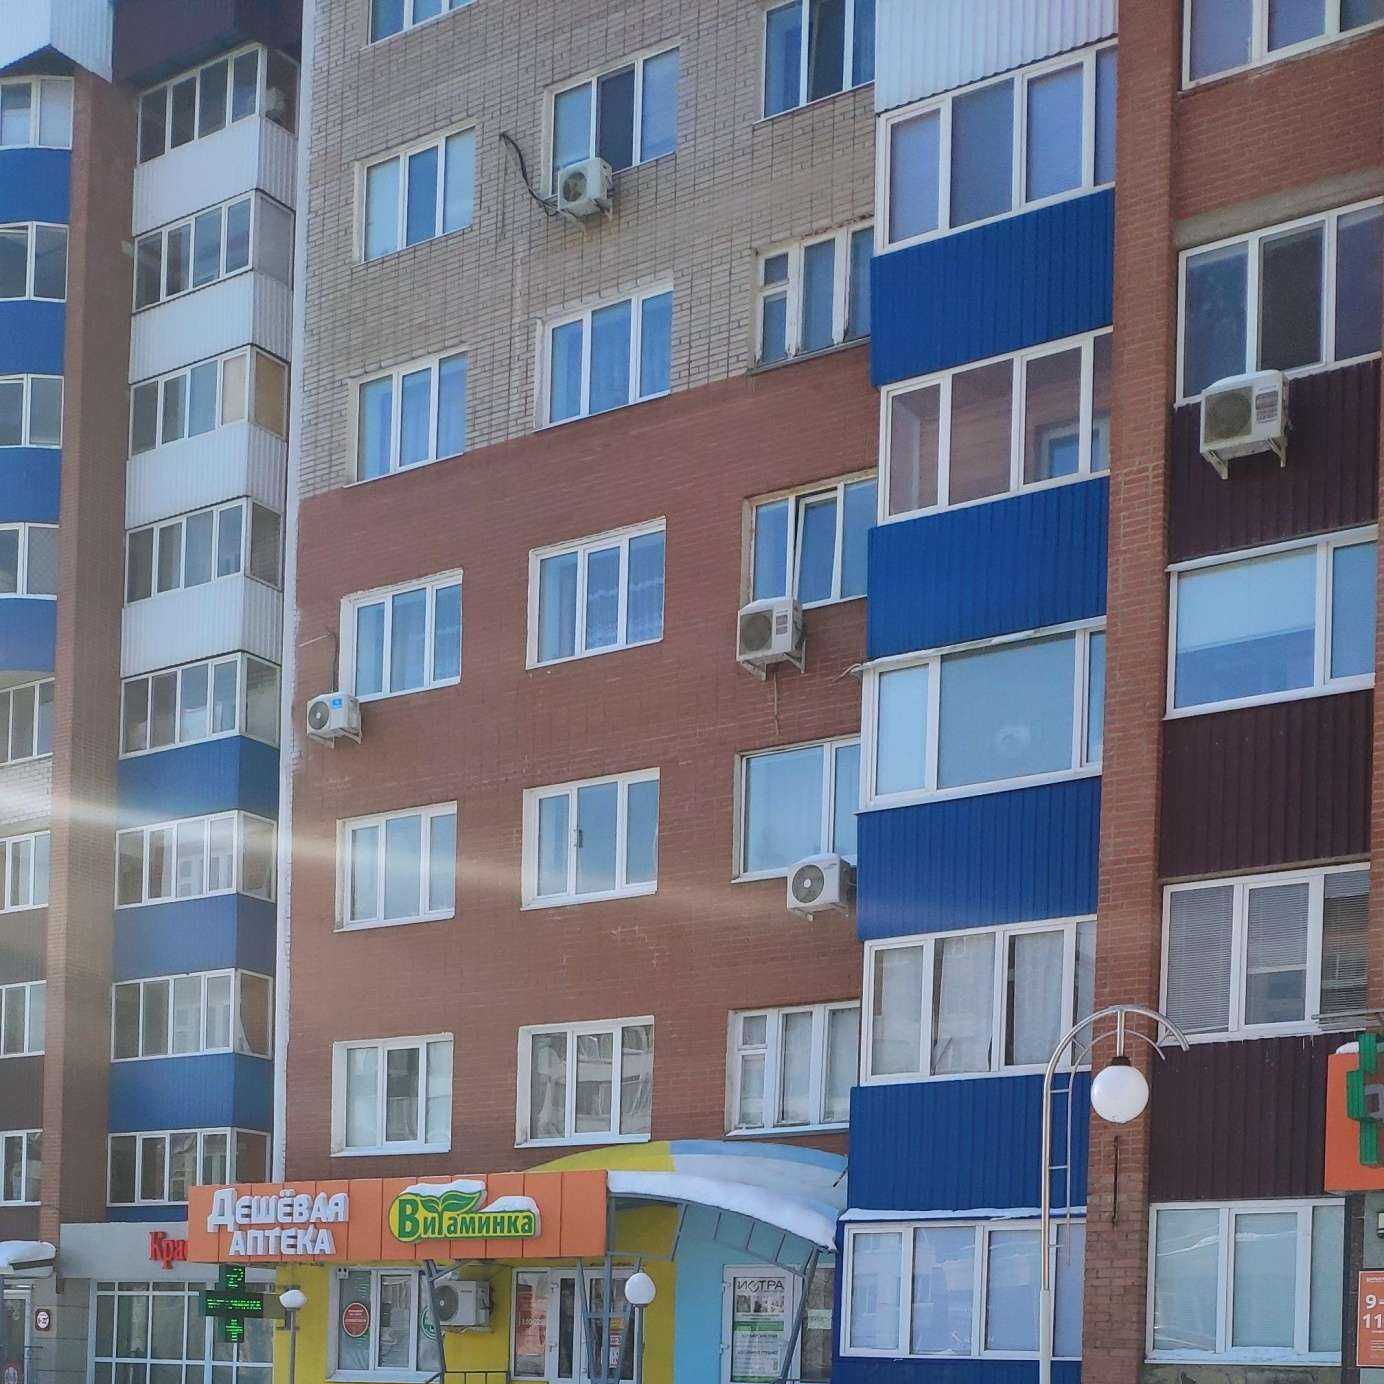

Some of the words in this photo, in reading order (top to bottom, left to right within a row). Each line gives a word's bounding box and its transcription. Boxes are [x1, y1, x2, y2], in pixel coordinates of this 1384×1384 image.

[207, 1188, 349, 1232] ДЕШЁВАЯ
[398, 1194, 533, 1238] Витаминка
[228, 1225, 336, 1256] АПТЕКА
[736, 1279, 784, 1293] ИСТРА
